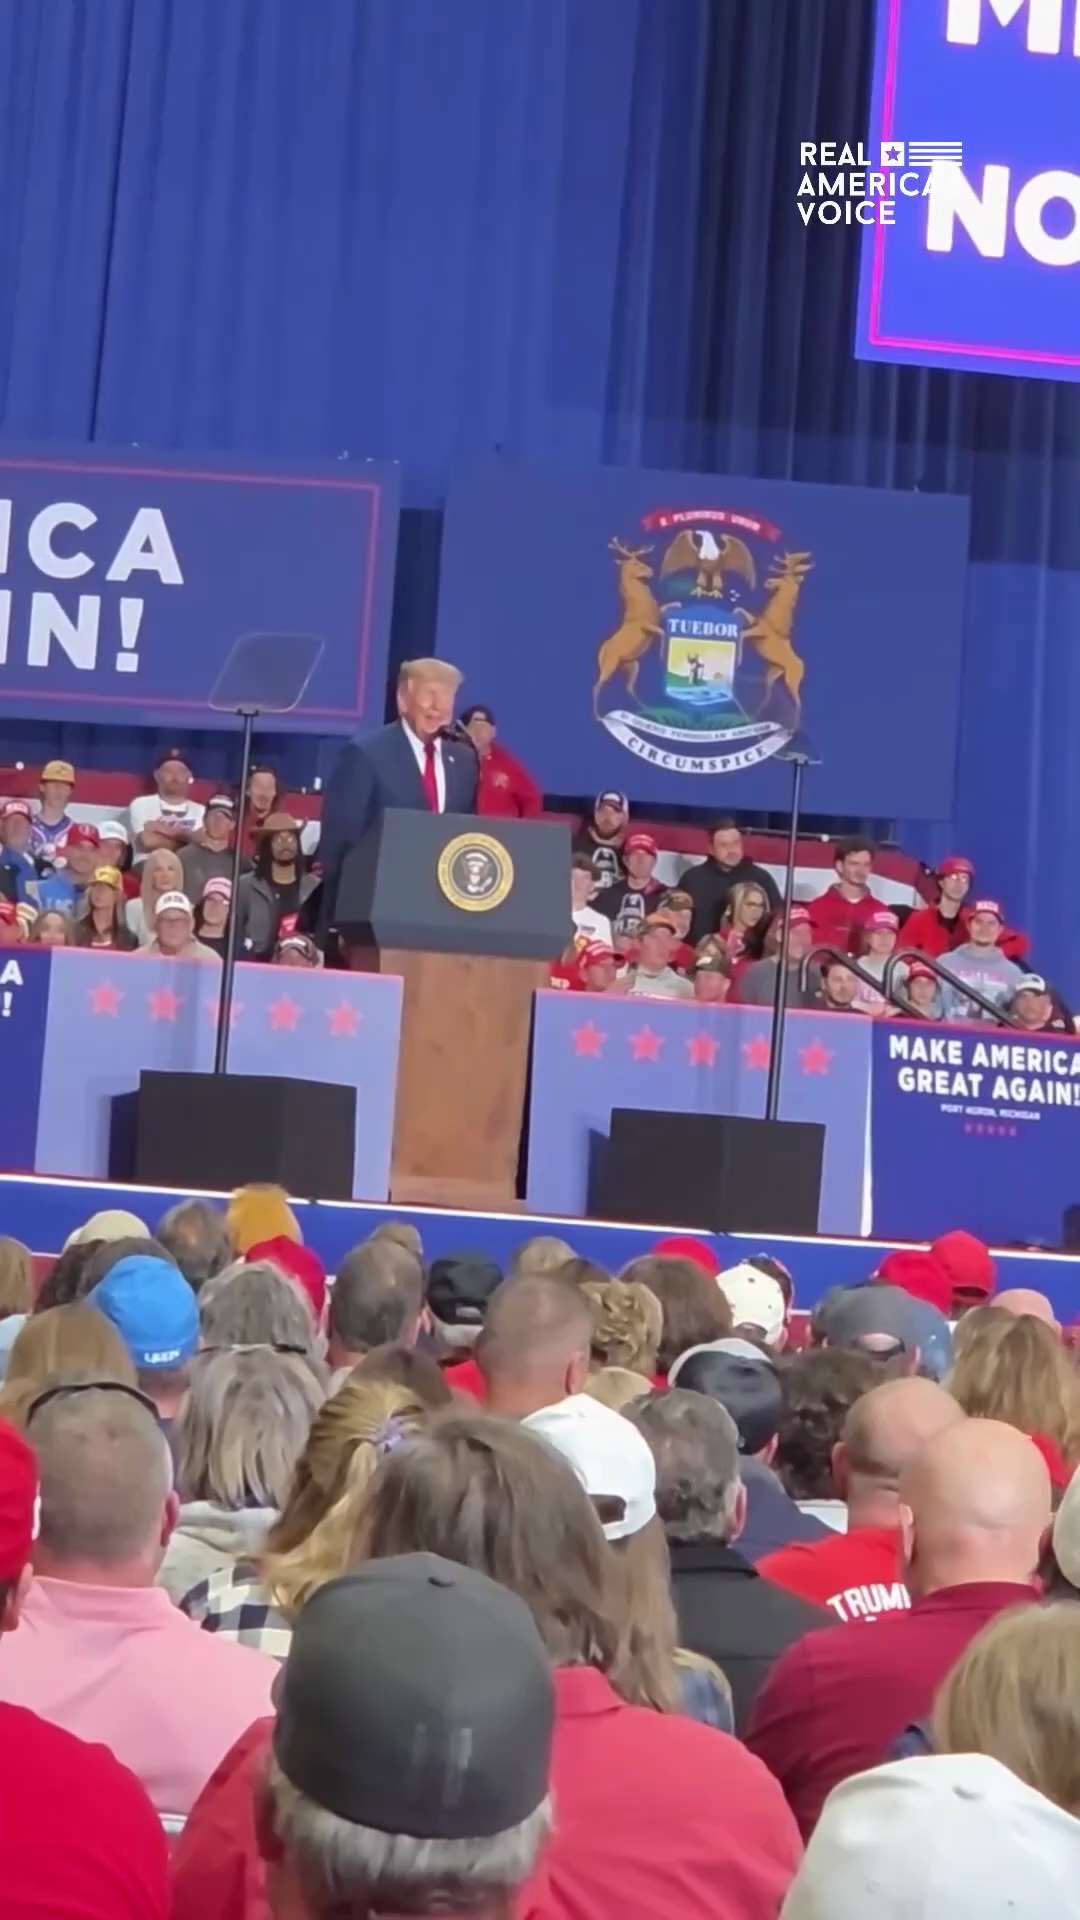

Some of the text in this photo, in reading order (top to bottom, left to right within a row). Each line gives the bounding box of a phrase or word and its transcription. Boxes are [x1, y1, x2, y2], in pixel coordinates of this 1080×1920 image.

[668, 618, 738, 638] TUEBOR
[628, 736, 768, 771] CIRCUMSPICE
[889, 1034, 1080, 1077] MAKE AMERICA
[898, 1066, 1080, 1107] GREAT AGAIN!
